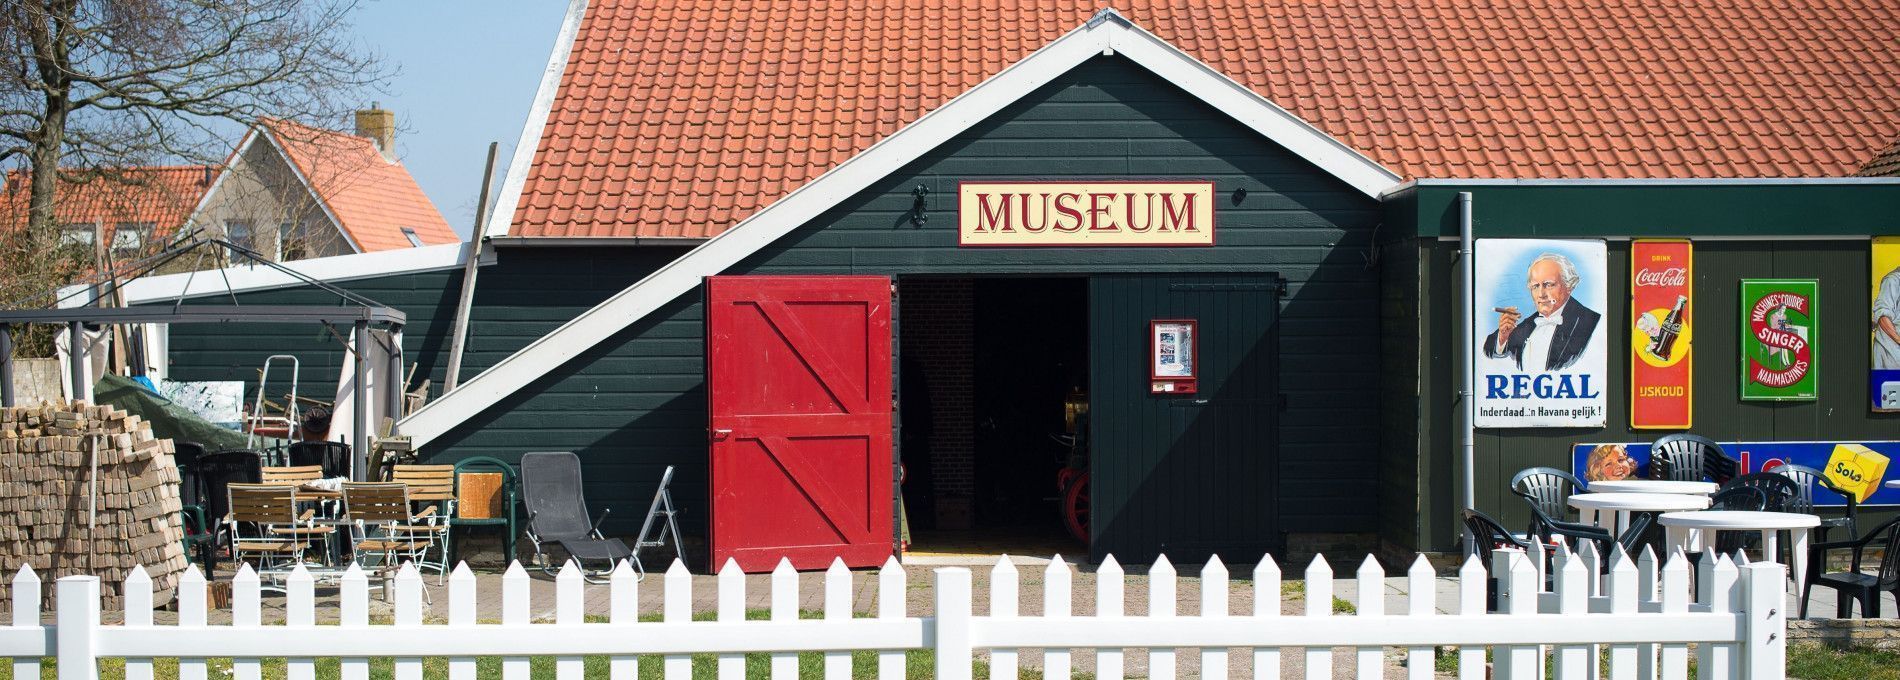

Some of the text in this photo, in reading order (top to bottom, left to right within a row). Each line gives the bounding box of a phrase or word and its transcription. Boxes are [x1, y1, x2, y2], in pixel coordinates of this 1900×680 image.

[973, 192, 1200, 233] MUSEUM
[1635, 267, 1687, 286] Coca-Cola
[1752, 294, 1779, 322] MACHINES
[1781, 293, 1805, 310] COUDRE
[1758, 327, 1804, 354] SINGER
[1757, 360, 1808, 385] NAAIMACHINES
[1485, 374, 1600, 399] REGAL
[1639, 386, 1684, 397] IJSKOUD
[1538, 406, 1569, 417] Havana
[1835, 462, 1862, 482] Solo
